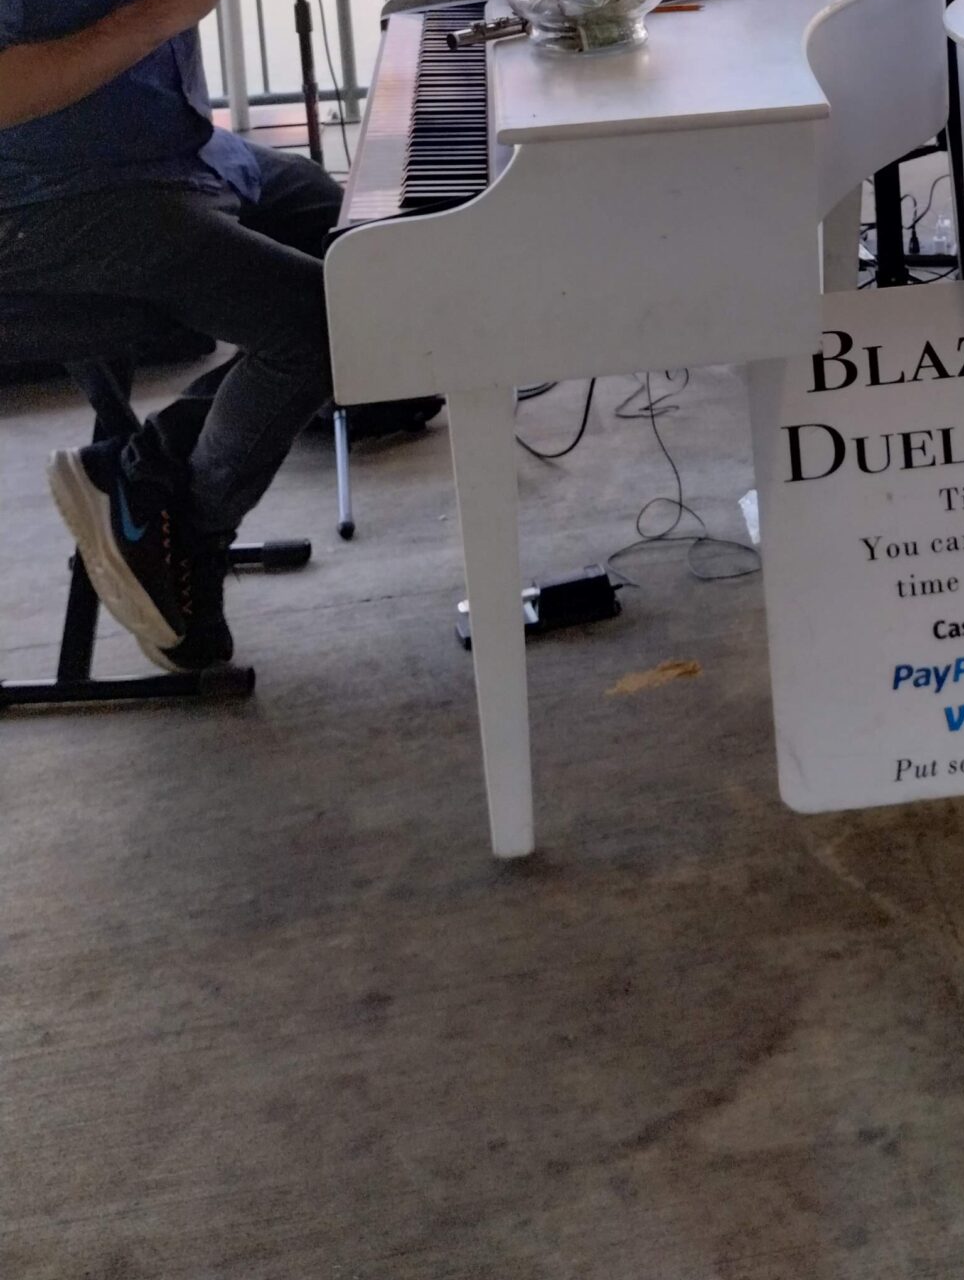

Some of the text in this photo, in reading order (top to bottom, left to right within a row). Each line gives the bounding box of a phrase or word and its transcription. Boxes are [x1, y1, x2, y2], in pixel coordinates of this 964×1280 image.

[860, 536, 919, 560] You
[897, 574, 958, 598] time
[895, 759, 936, 782] Put
